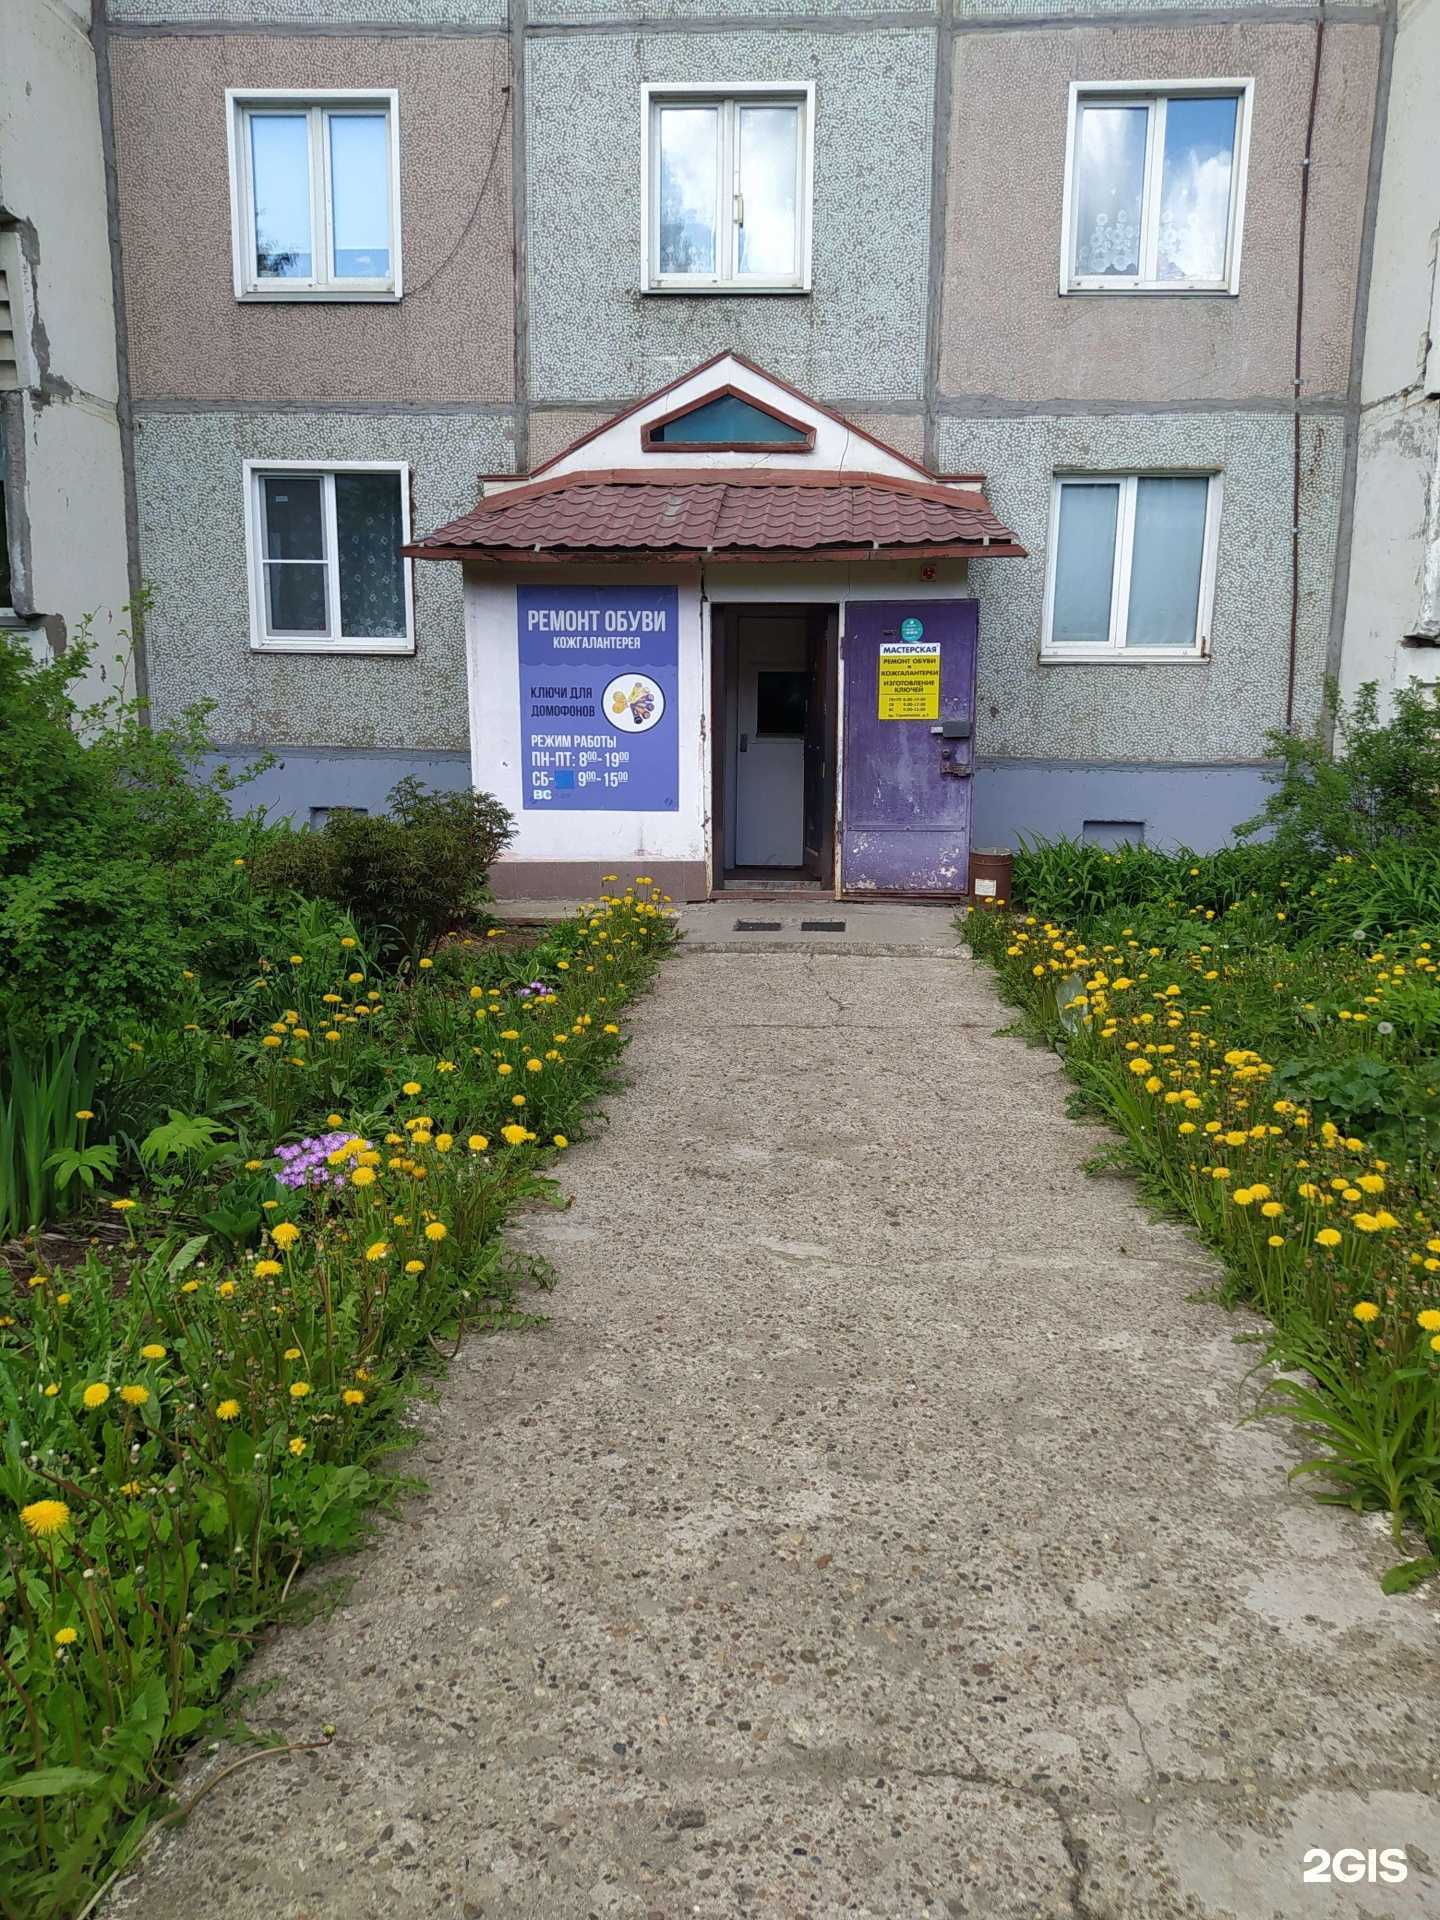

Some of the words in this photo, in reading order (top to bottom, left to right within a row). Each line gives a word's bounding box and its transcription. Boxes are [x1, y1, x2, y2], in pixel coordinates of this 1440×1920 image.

[528, 610, 600, 632] РЕМОНТ
[604, 610, 666, 632] ОБУВИ
[553, 636, 641, 649] КОЖГАЛАНТЕРЕЯ
[883, 646, 937, 654] МАСТЕРСКАЯ
[530, 687, 568, 699] КЛЮЧИ
[569, 687, 593, 700] ДЛЯ
[530, 704, 596, 717] ДОМОФОНОВ
[531, 734, 572, 748] РЕЖИМ
[574, 735, 617, 748] РАБОТЫ
[531, 751, 576, 767] ПН-ПТ:
[533, 790, 553, 800] ВС
